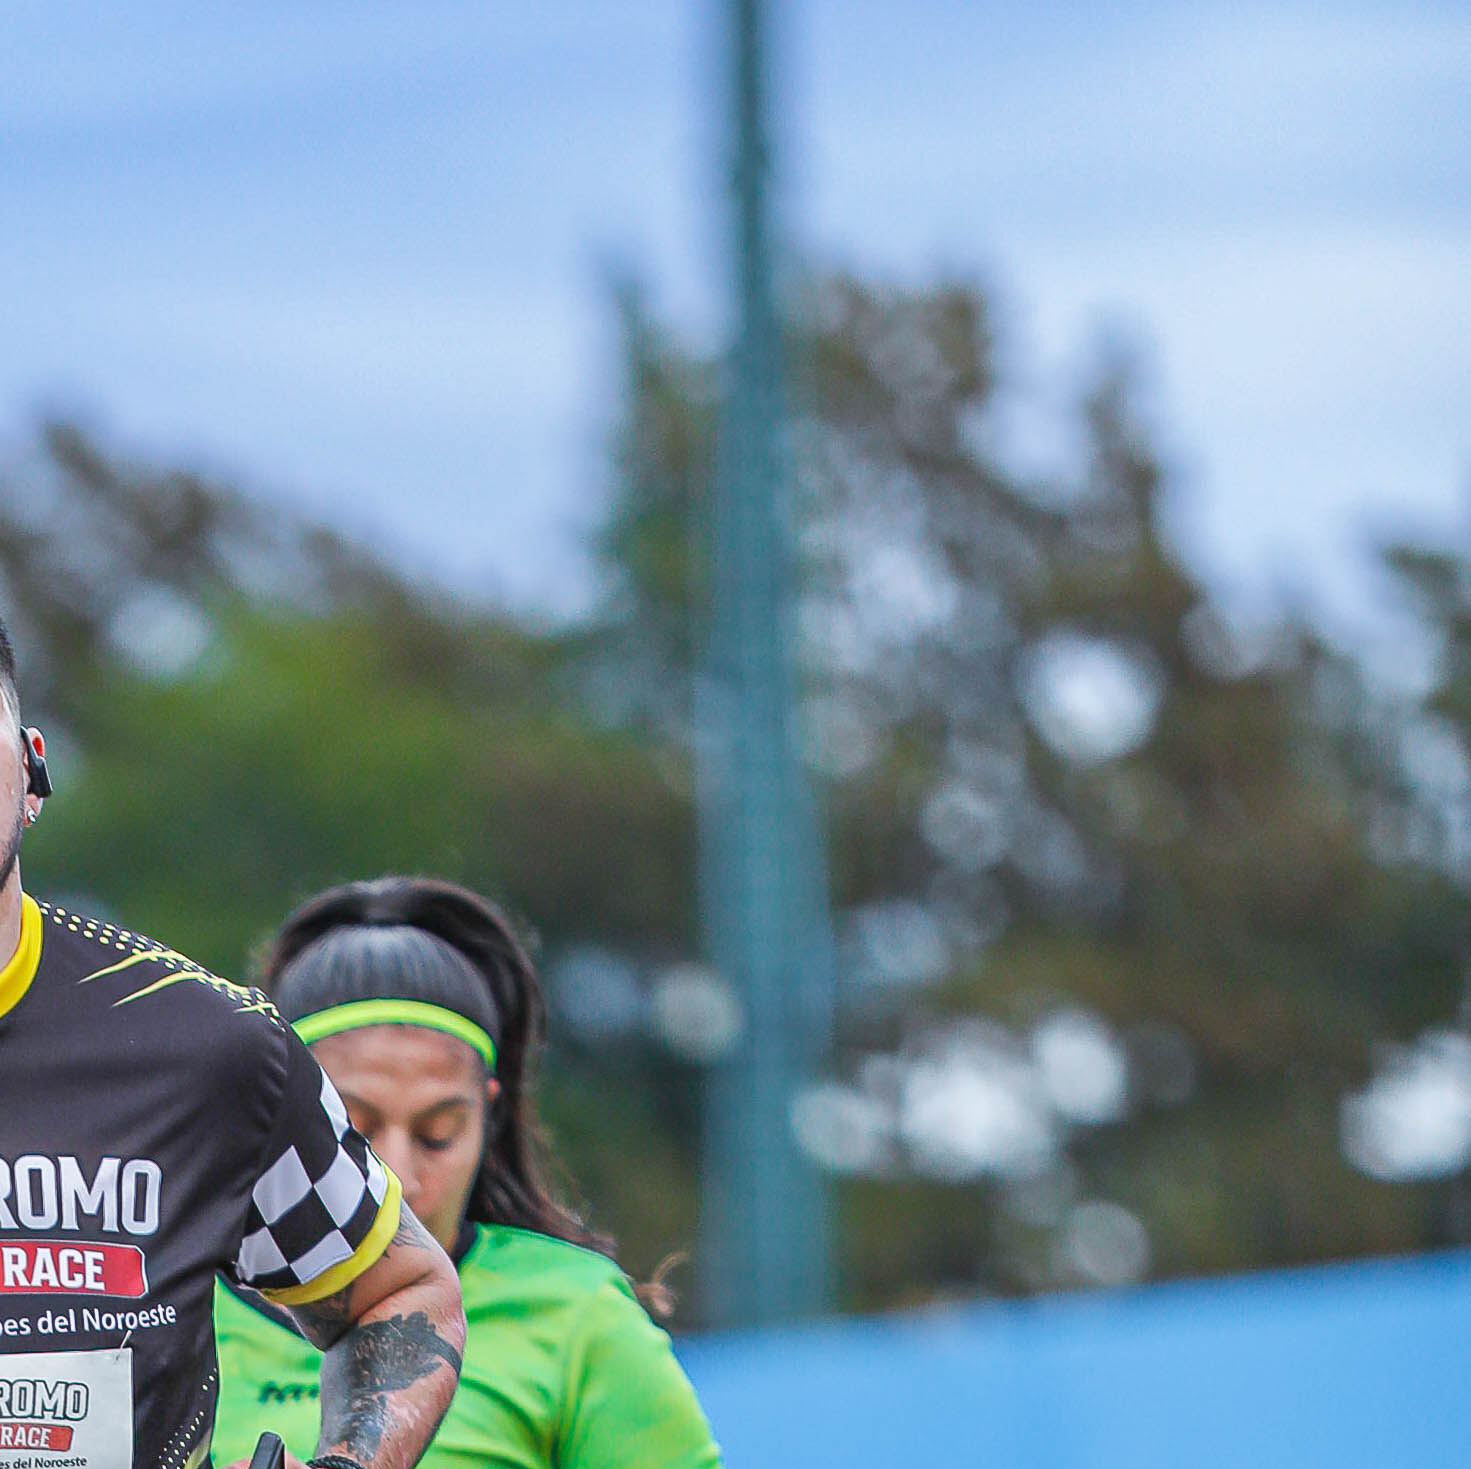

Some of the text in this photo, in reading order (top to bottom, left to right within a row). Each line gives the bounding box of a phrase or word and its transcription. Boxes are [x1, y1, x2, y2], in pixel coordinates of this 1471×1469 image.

[2, 1245, 106, 1291] RACE
[37, 1309, 77, 1335] del
[82, 1303, 177, 1332] Noroeste
[0, 1425, 52, 1449] RACE
[12, 1457, 32, 1469] del
[34, 1455, 88, 1469] Noroeste
